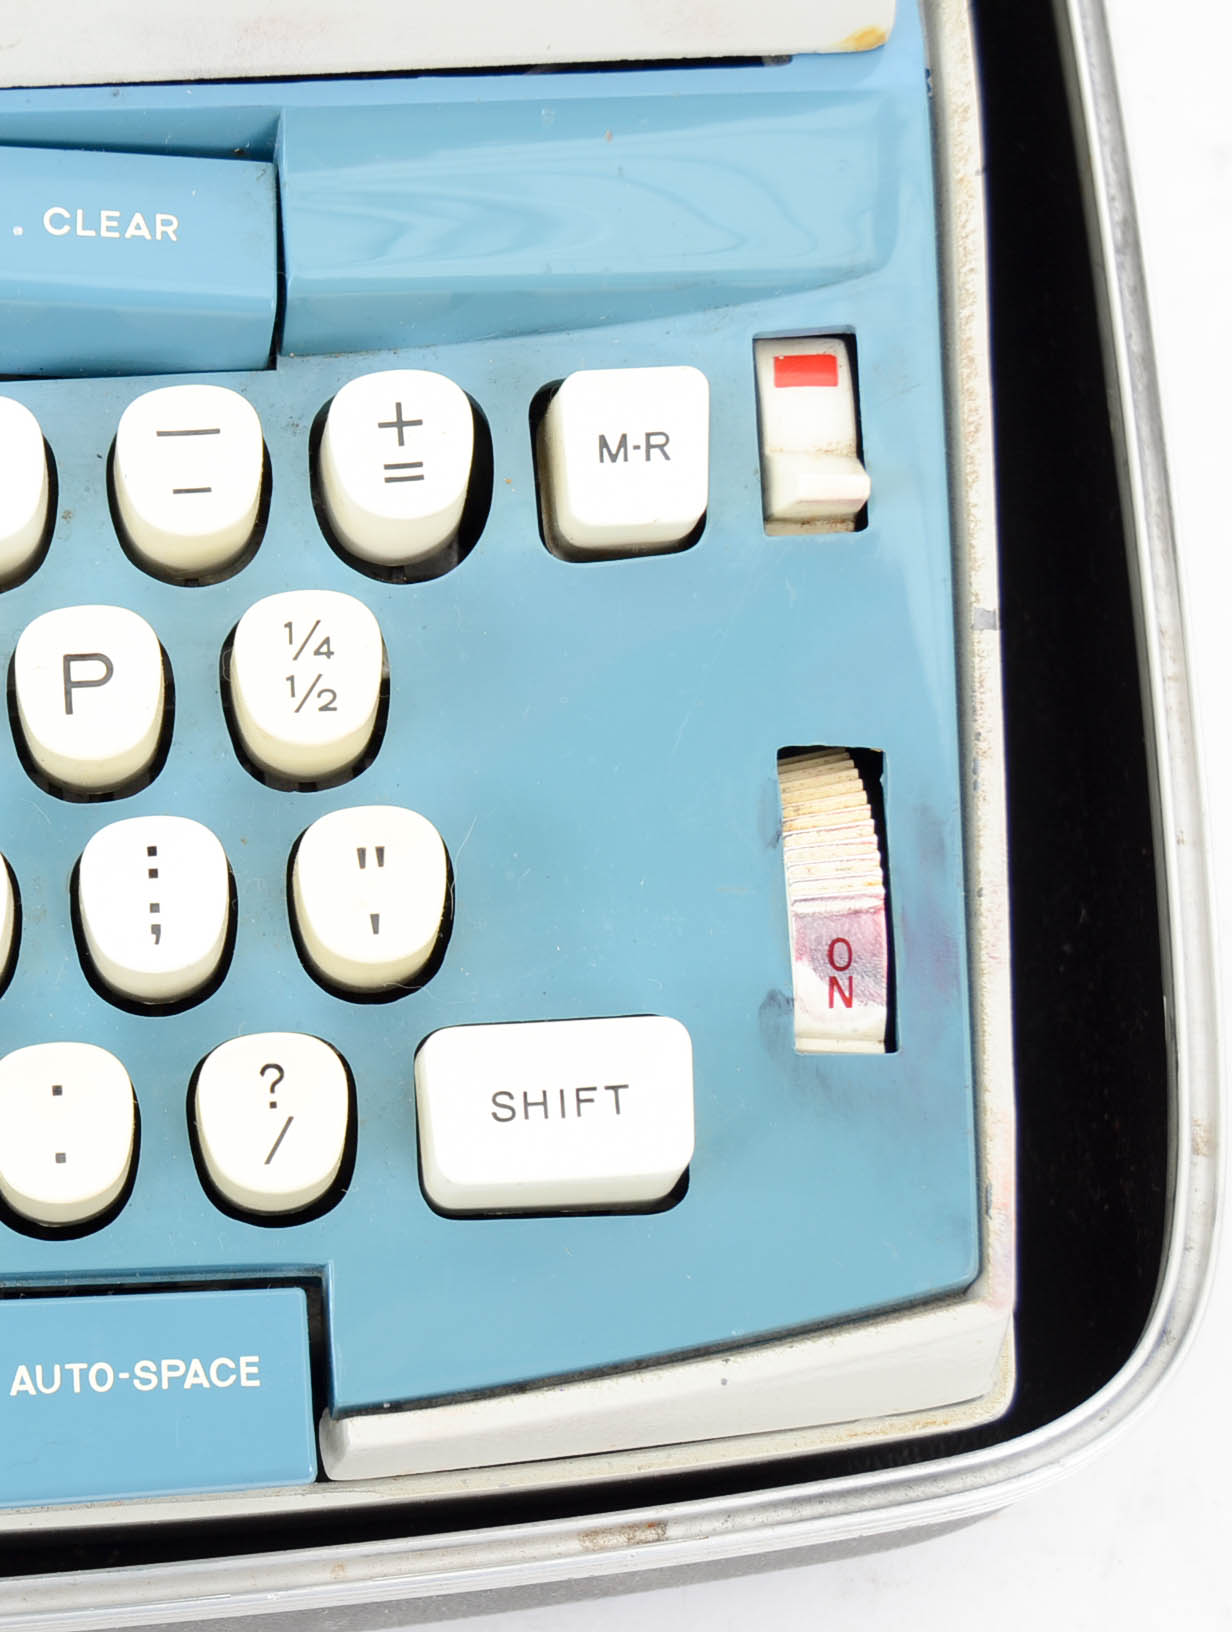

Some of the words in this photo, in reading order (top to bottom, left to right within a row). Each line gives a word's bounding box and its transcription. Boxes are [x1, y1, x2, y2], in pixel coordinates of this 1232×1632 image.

[43, 206, 179, 242] CLEAR
[377, 401, 424, 447] +
[598, 431, 671, 464] M-R
[383, 461, 425, 484] =
[62, 652, 114, 716] P
[149, 902, 162, 946] ;
[259, 1063, 285, 1110] ?
[491, 1083, 630, 1123] SHIFT
[263, 1115, 295, 1165] /
[9, 1355, 261, 1396] AUTO-SPACE
